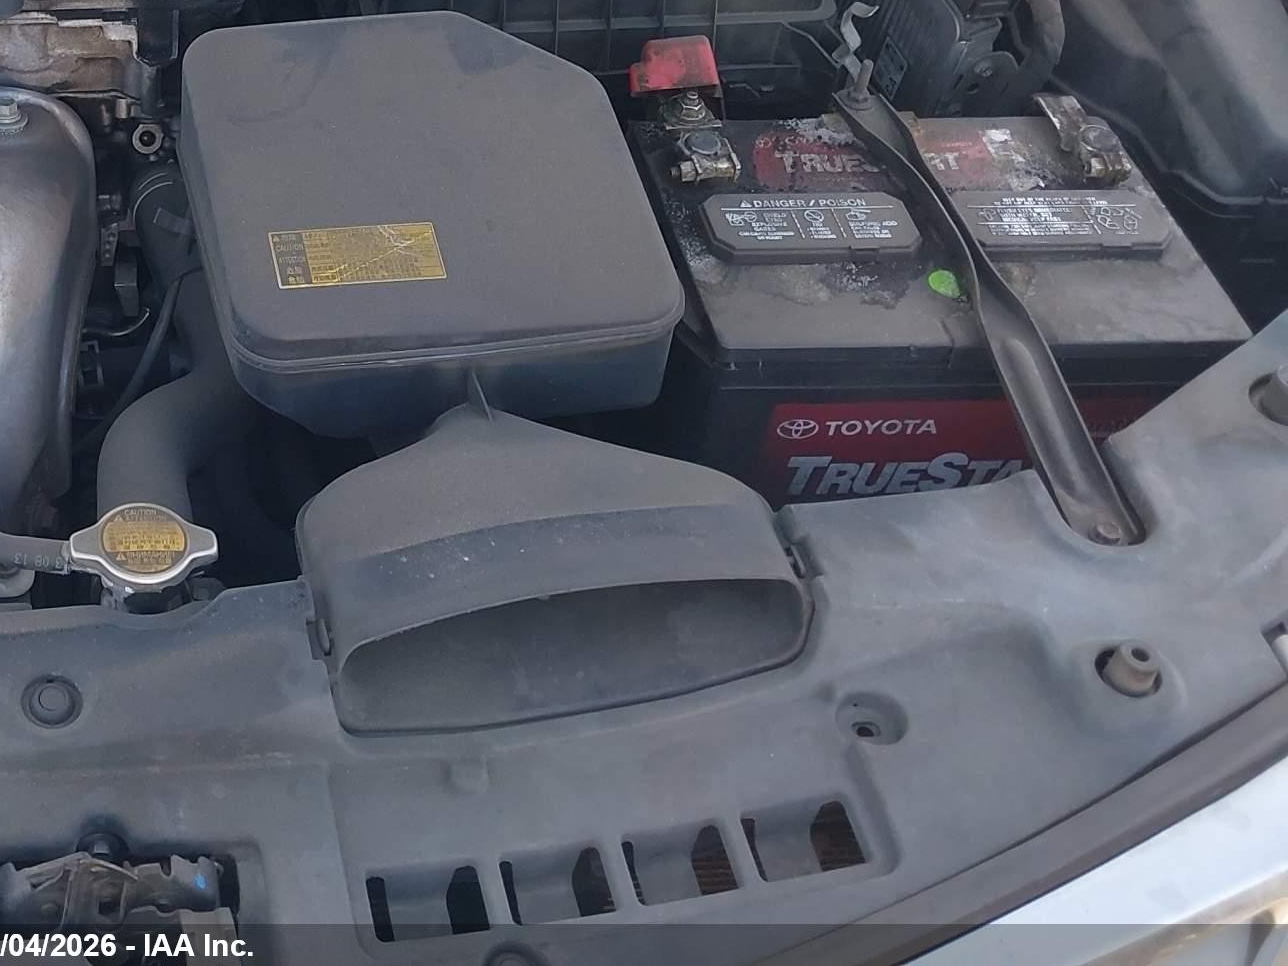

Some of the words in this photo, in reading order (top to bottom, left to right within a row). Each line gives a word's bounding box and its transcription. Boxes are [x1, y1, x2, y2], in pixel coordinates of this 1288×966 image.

[753, 199, 806, 208] DANGER
[819, 198, 867, 207] POISON
[825, 419, 937, 436] TOYOTA
